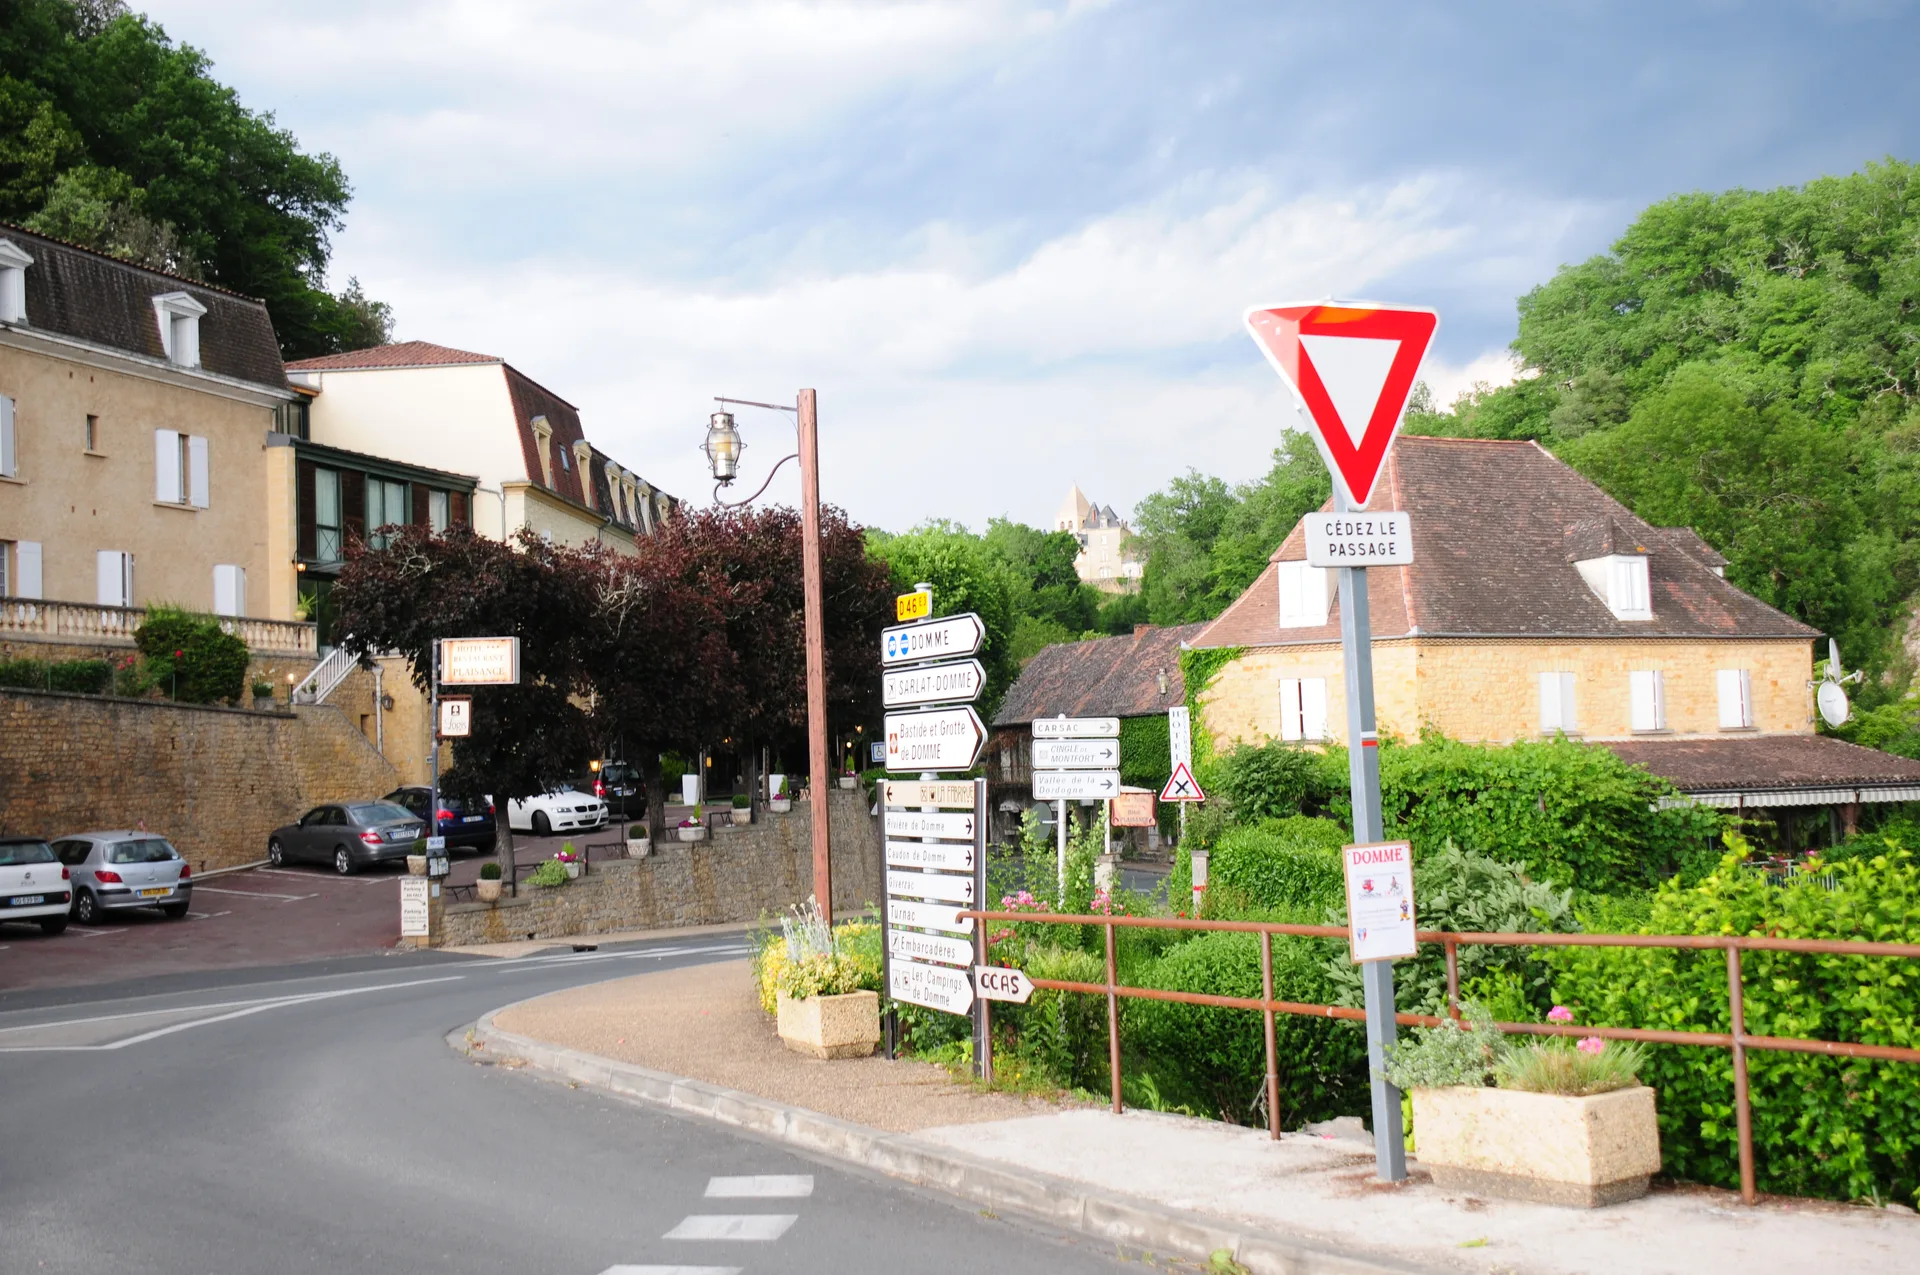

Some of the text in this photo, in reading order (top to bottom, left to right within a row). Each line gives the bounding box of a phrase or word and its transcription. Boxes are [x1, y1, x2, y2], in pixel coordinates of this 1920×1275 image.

[1326, 520, 1396, 536] CÉDEZ LE
[1329, 542, 1396, 556] PASSAGE
[912, 630, 949, 650] DOMME
[454, 655, 504, 663] RESTAURANT
[453, 667, 504, 676] PLAISANCE
[900, 720, 966, 738] Bastide et Grotte
[1038, 724, 1079, 732] CARSAC
[901, 744, 940, 760] de DOMME
[1051, 744, 1078, 752] CINGLE
[1051, 755, 1095, 763] MONTFORT
[1039, 776, 1095, 784] Vallée de la
[1039, 786, 1084, 796] Dordogne
[887, 818, 945, 832] Rivière de Domme
[888, 848, 946, 862] Caudon de Domme
[1352, 848, 1404, 865] DOMME
[891, 905, 916, 922] Turnac
[901, 936, 956, 959] Embarcadères
[912, 968, 962, 994] Les Campings
[980, 973, 1019, 995] CCAS
[913, 985, 950, 1007] de Domme
